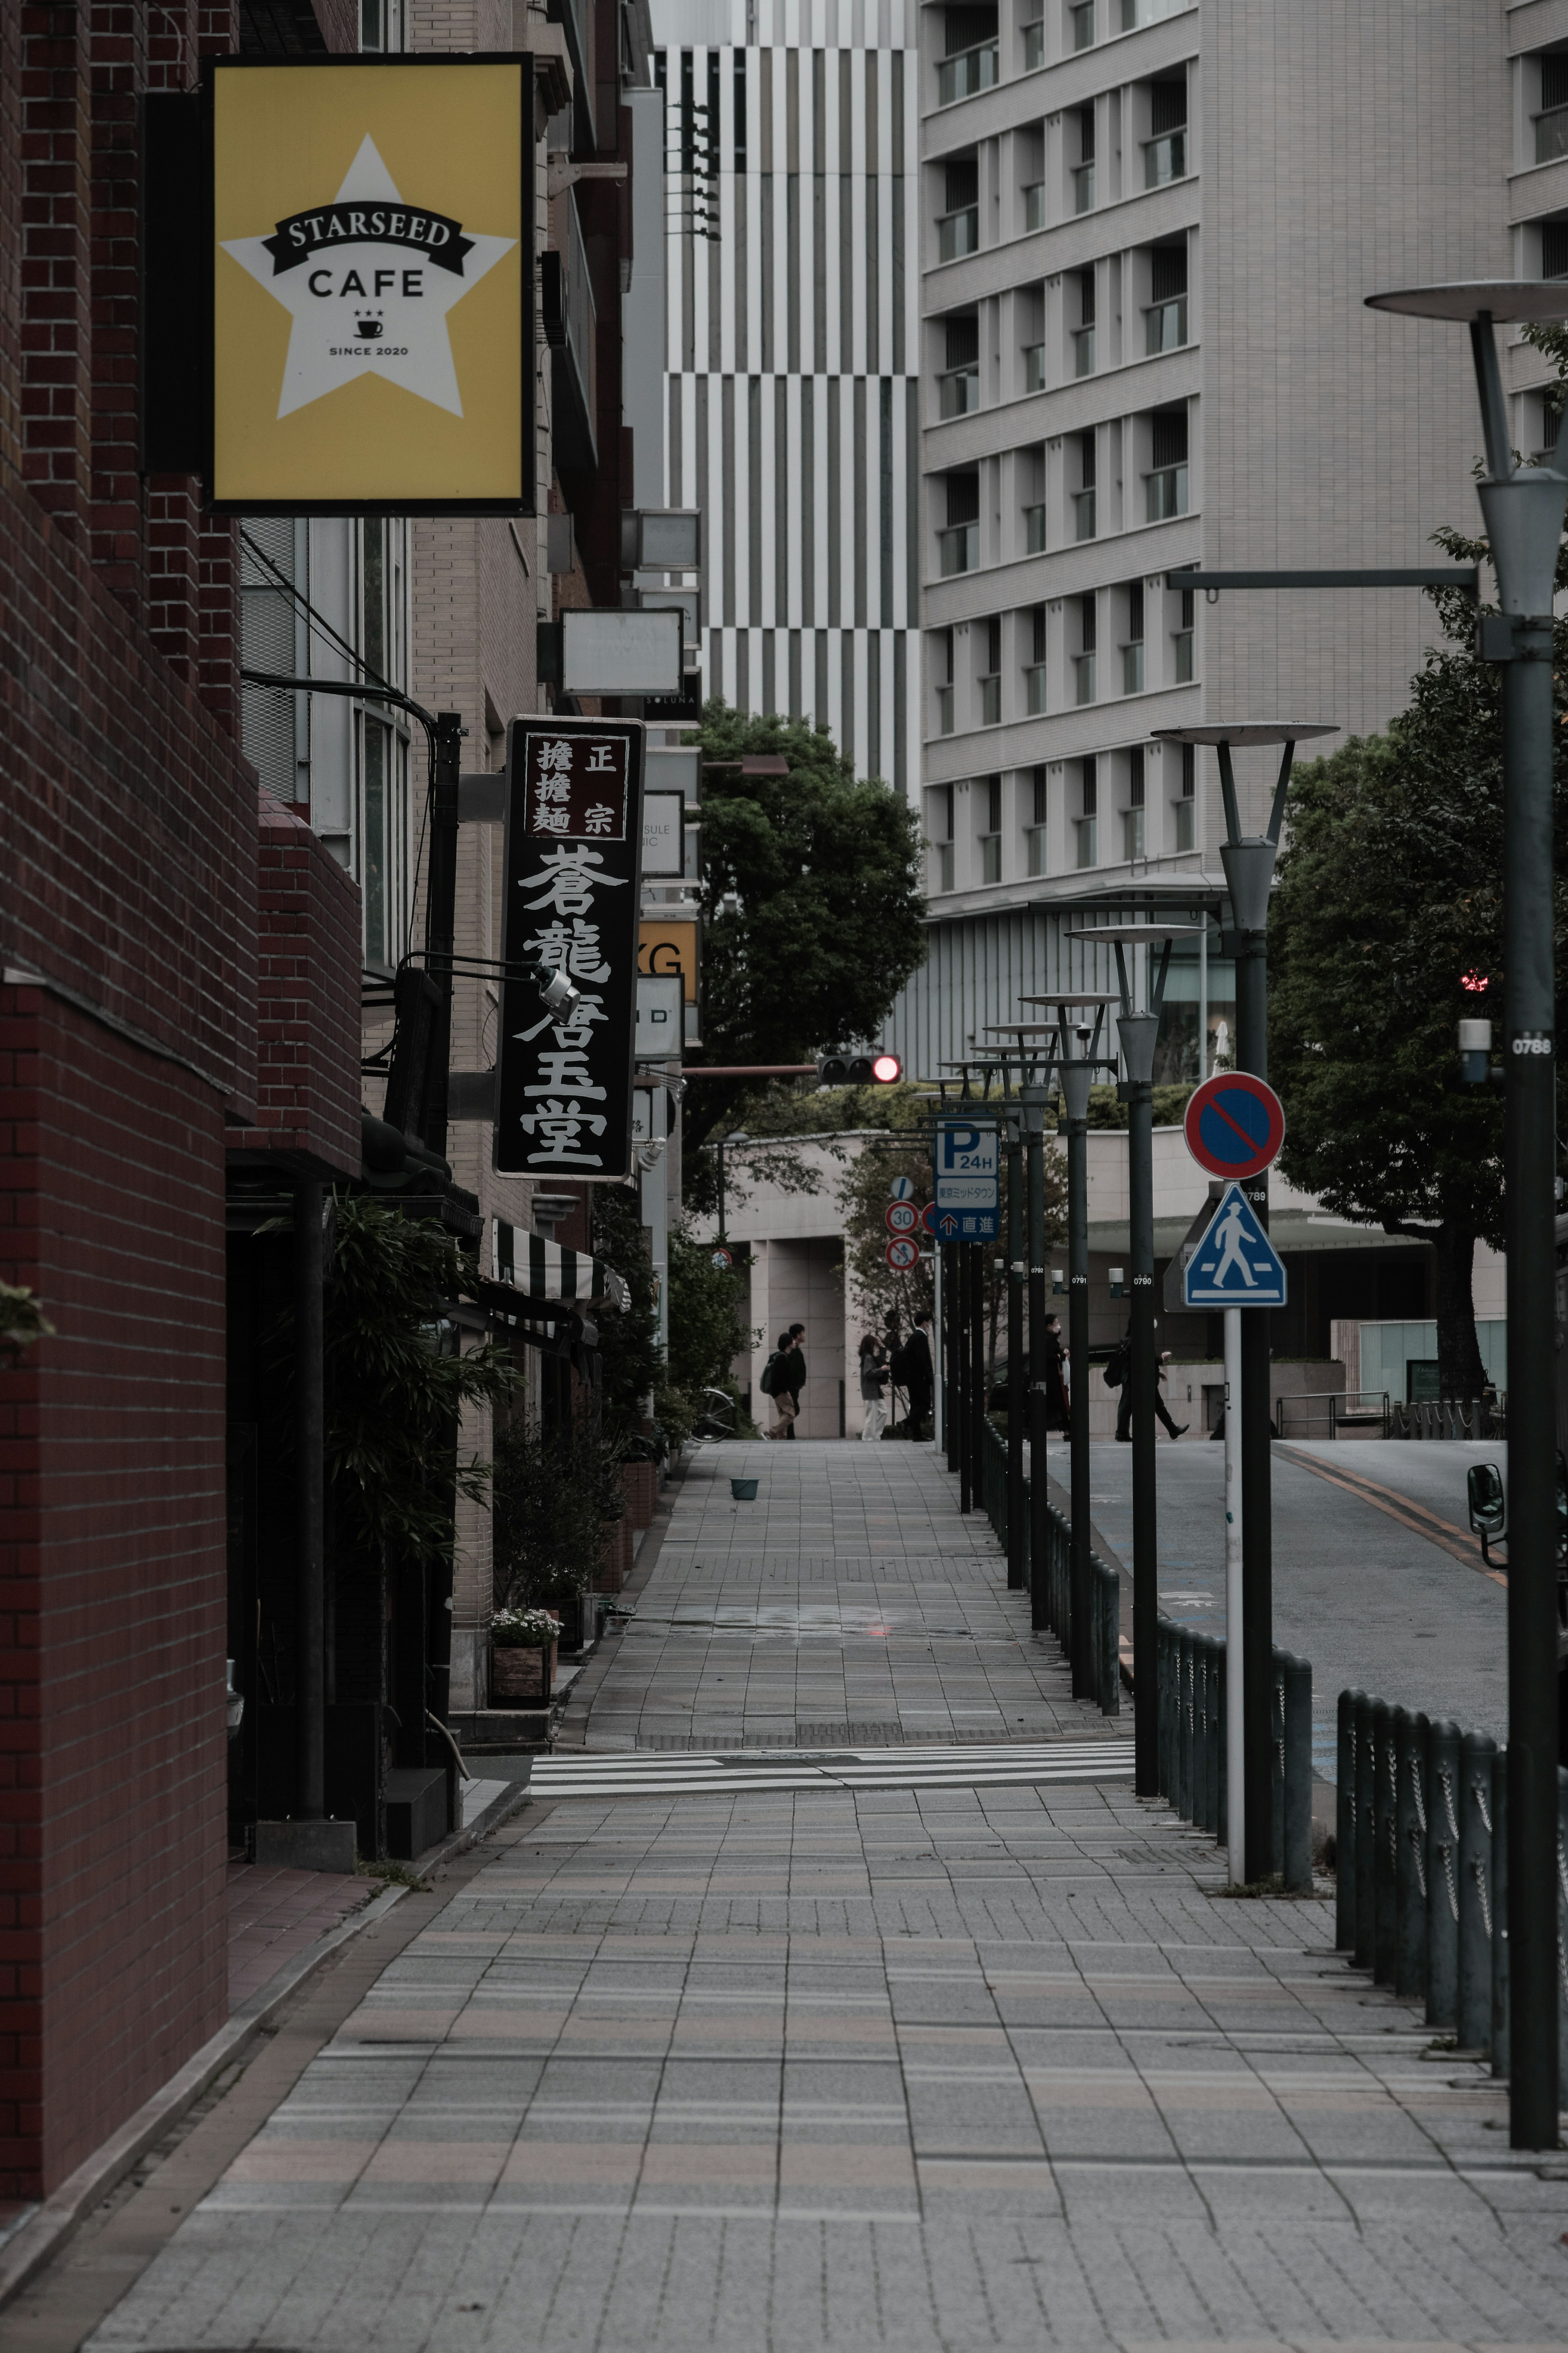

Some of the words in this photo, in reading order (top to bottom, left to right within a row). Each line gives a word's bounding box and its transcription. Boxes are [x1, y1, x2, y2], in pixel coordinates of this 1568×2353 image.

[288, 211, 451, 247] STARSEED
[308, 270, 423, 297] CAFE
[584, 745, 617, 834] 正宗
[644, 825, 670, 834] SULE
[1512, 1038, 1552, 1055] 0788
[944, 1122, 980, 1169] P
[960, 1155, 992, 1169] 24H
[939, 1188, 995, 1199] 東京ミッドタウン
[893, 1211, 911, 1225] 30
[962, 1216, 994, 1233] 直進
